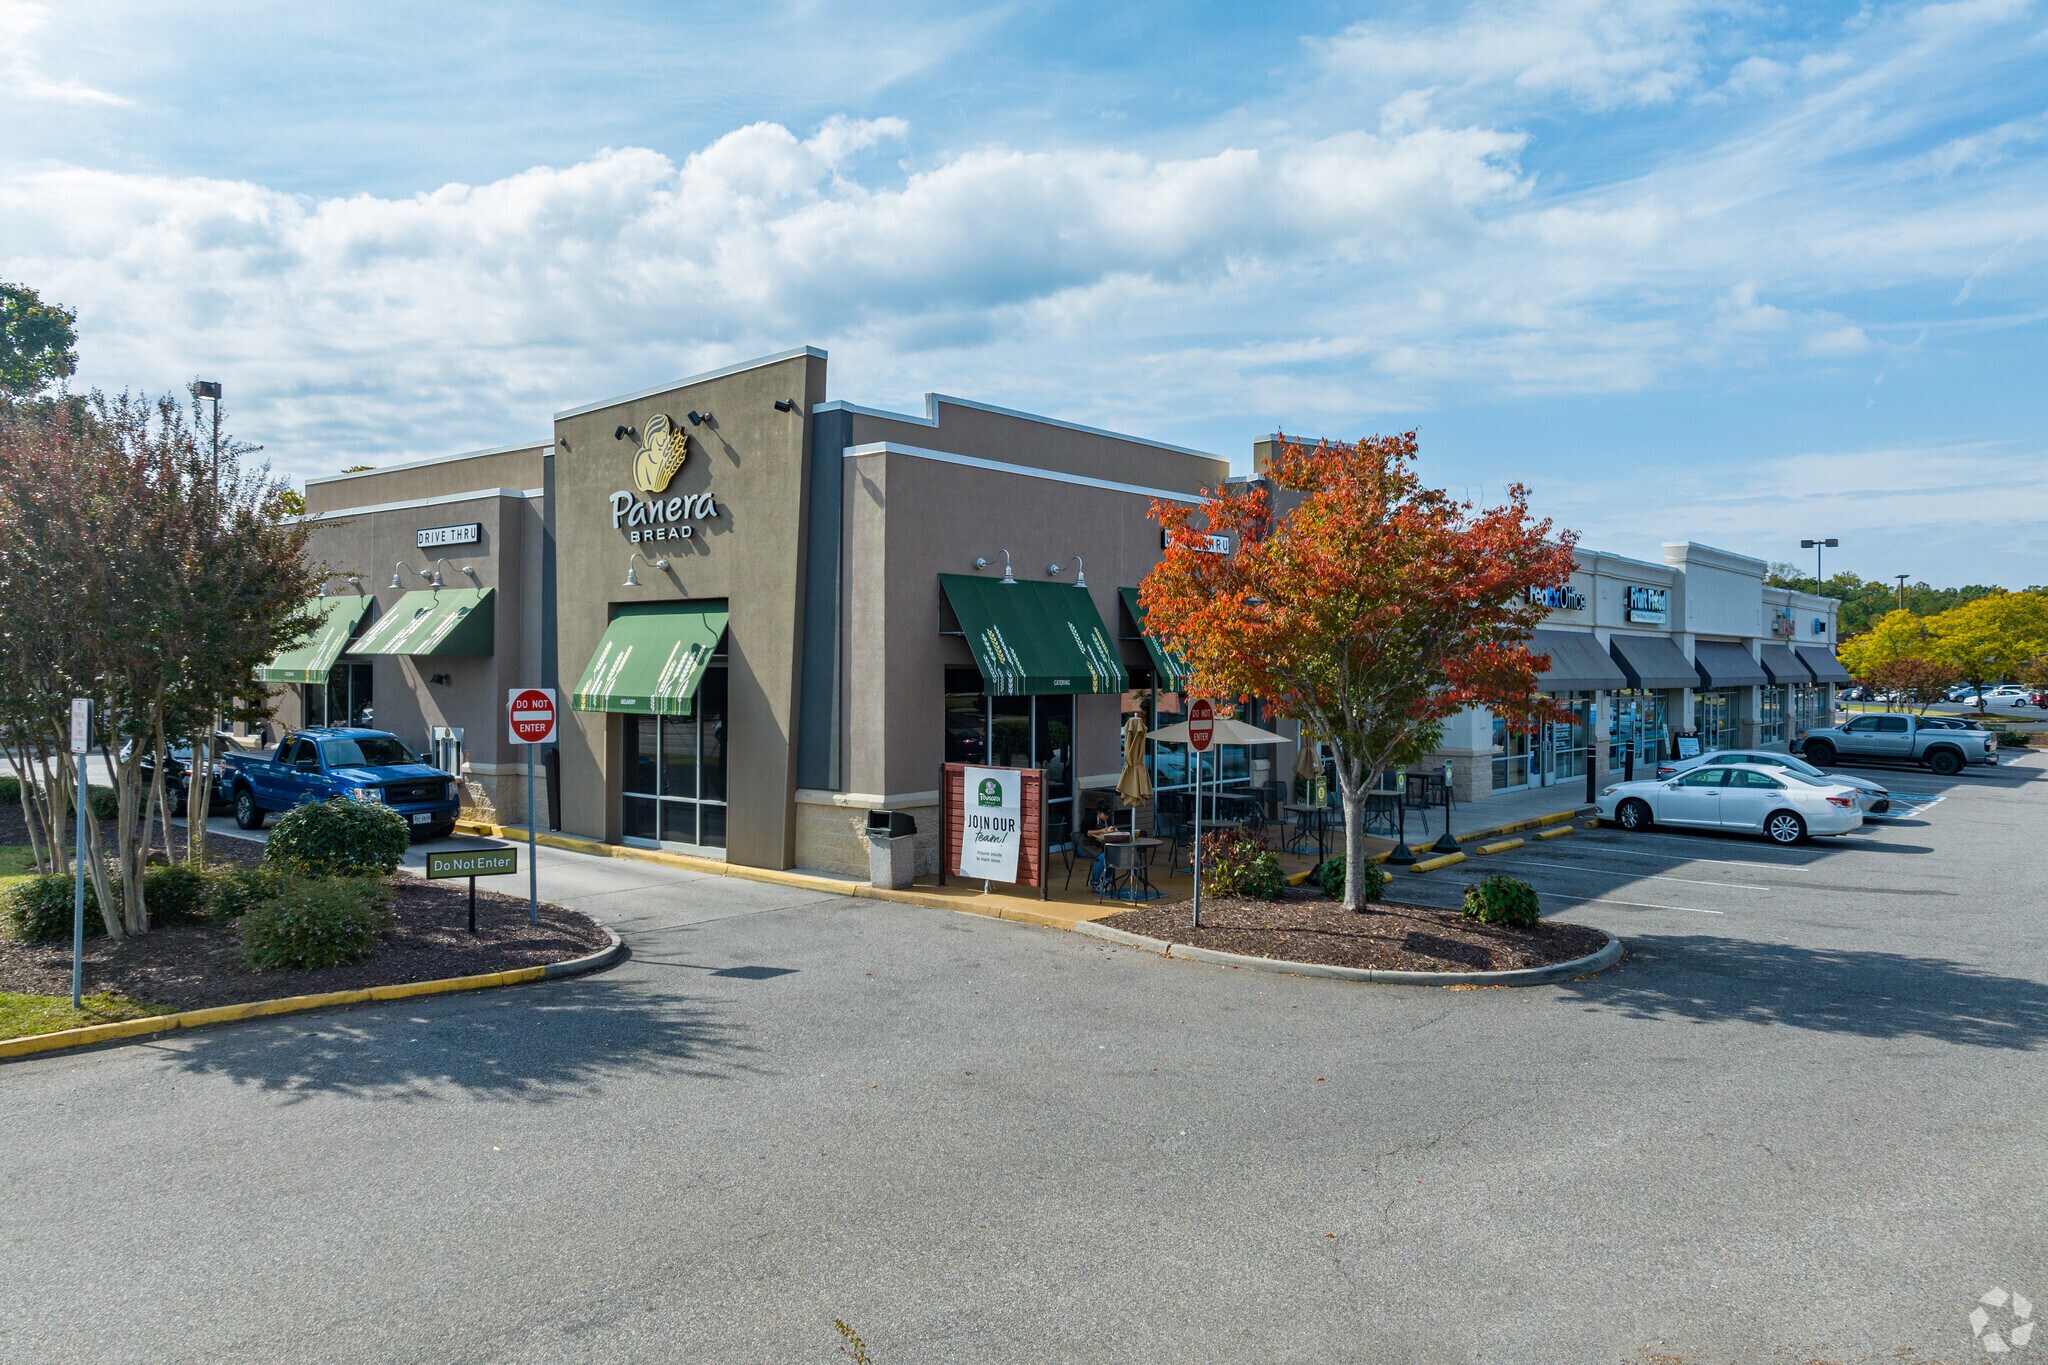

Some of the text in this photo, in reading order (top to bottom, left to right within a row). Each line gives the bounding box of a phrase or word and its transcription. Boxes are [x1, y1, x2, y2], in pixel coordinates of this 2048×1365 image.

[609, 489, 718, 529] Panera
[419, 527, 476, 544] DRIVE THRU
[630, 525, 692, 543] BREAD
[516, 699, 549, 709] DO NOT
[1192, 709, 1211, 718] DO NOT
[519, 723, 546, 733] ENTER
[1193, 732, 1209, 742] ENTER
[968, 814, 1016, 833] JOIN OUR
[974, 828, 1009, 848] team!
[434, 857, 511, 872] Do Not Enter
